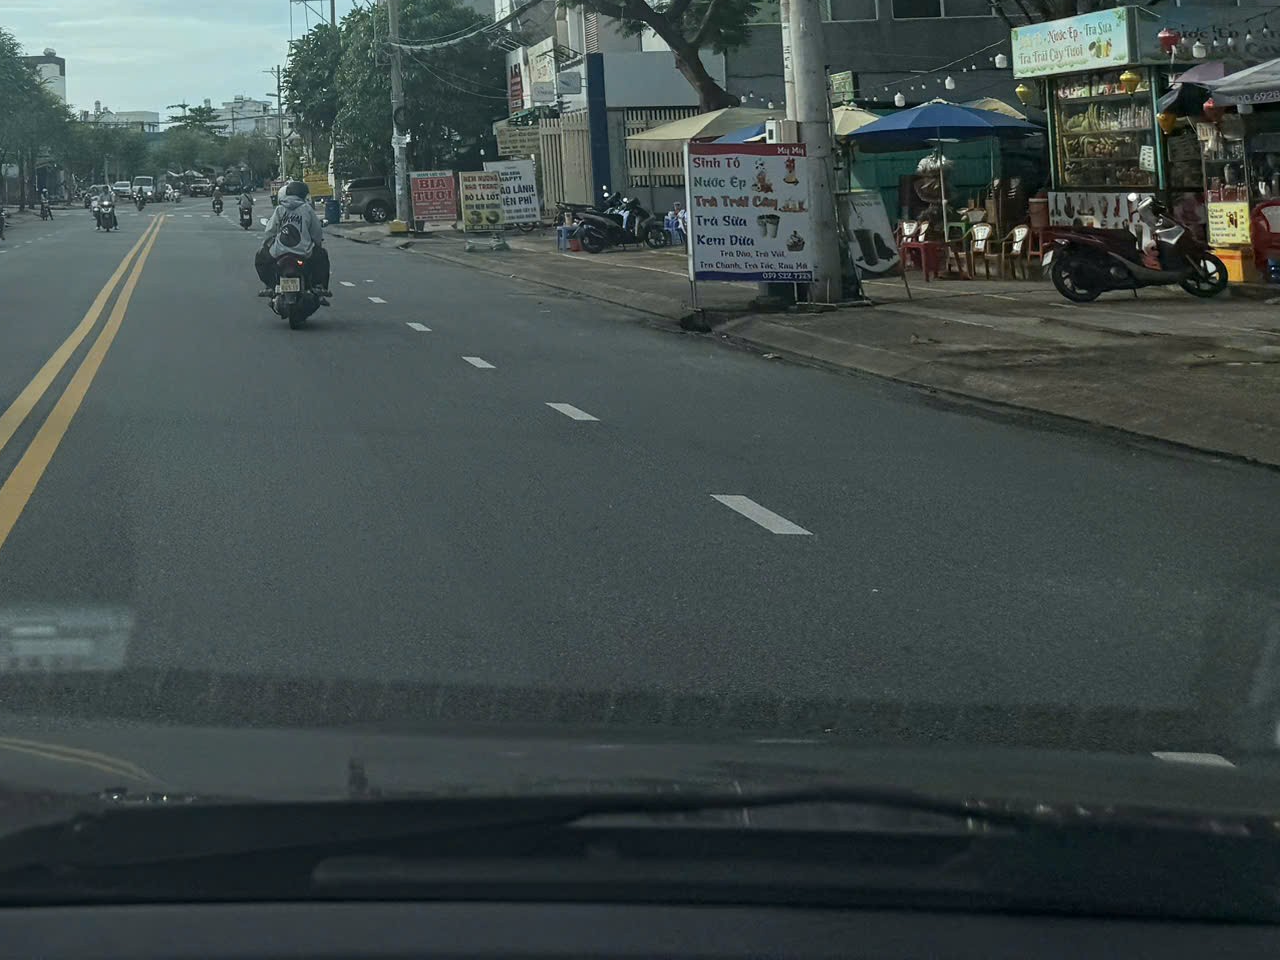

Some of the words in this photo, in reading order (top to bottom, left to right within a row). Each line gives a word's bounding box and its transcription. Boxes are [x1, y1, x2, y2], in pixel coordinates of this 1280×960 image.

[692, 157, 721, 169] Sinh
[418, 178, 446, 189] BIA
[693, 176, 726, 188] Nước
[693, 195, 718, 208] Trà
[720, 195, 750, 208] Trái
[751, 195, 779, 211] Cây
[694, 215, 718, 227] Trà
[696, 234, 726, 246] Kem
[729, 234, 756, 247] Dừa
